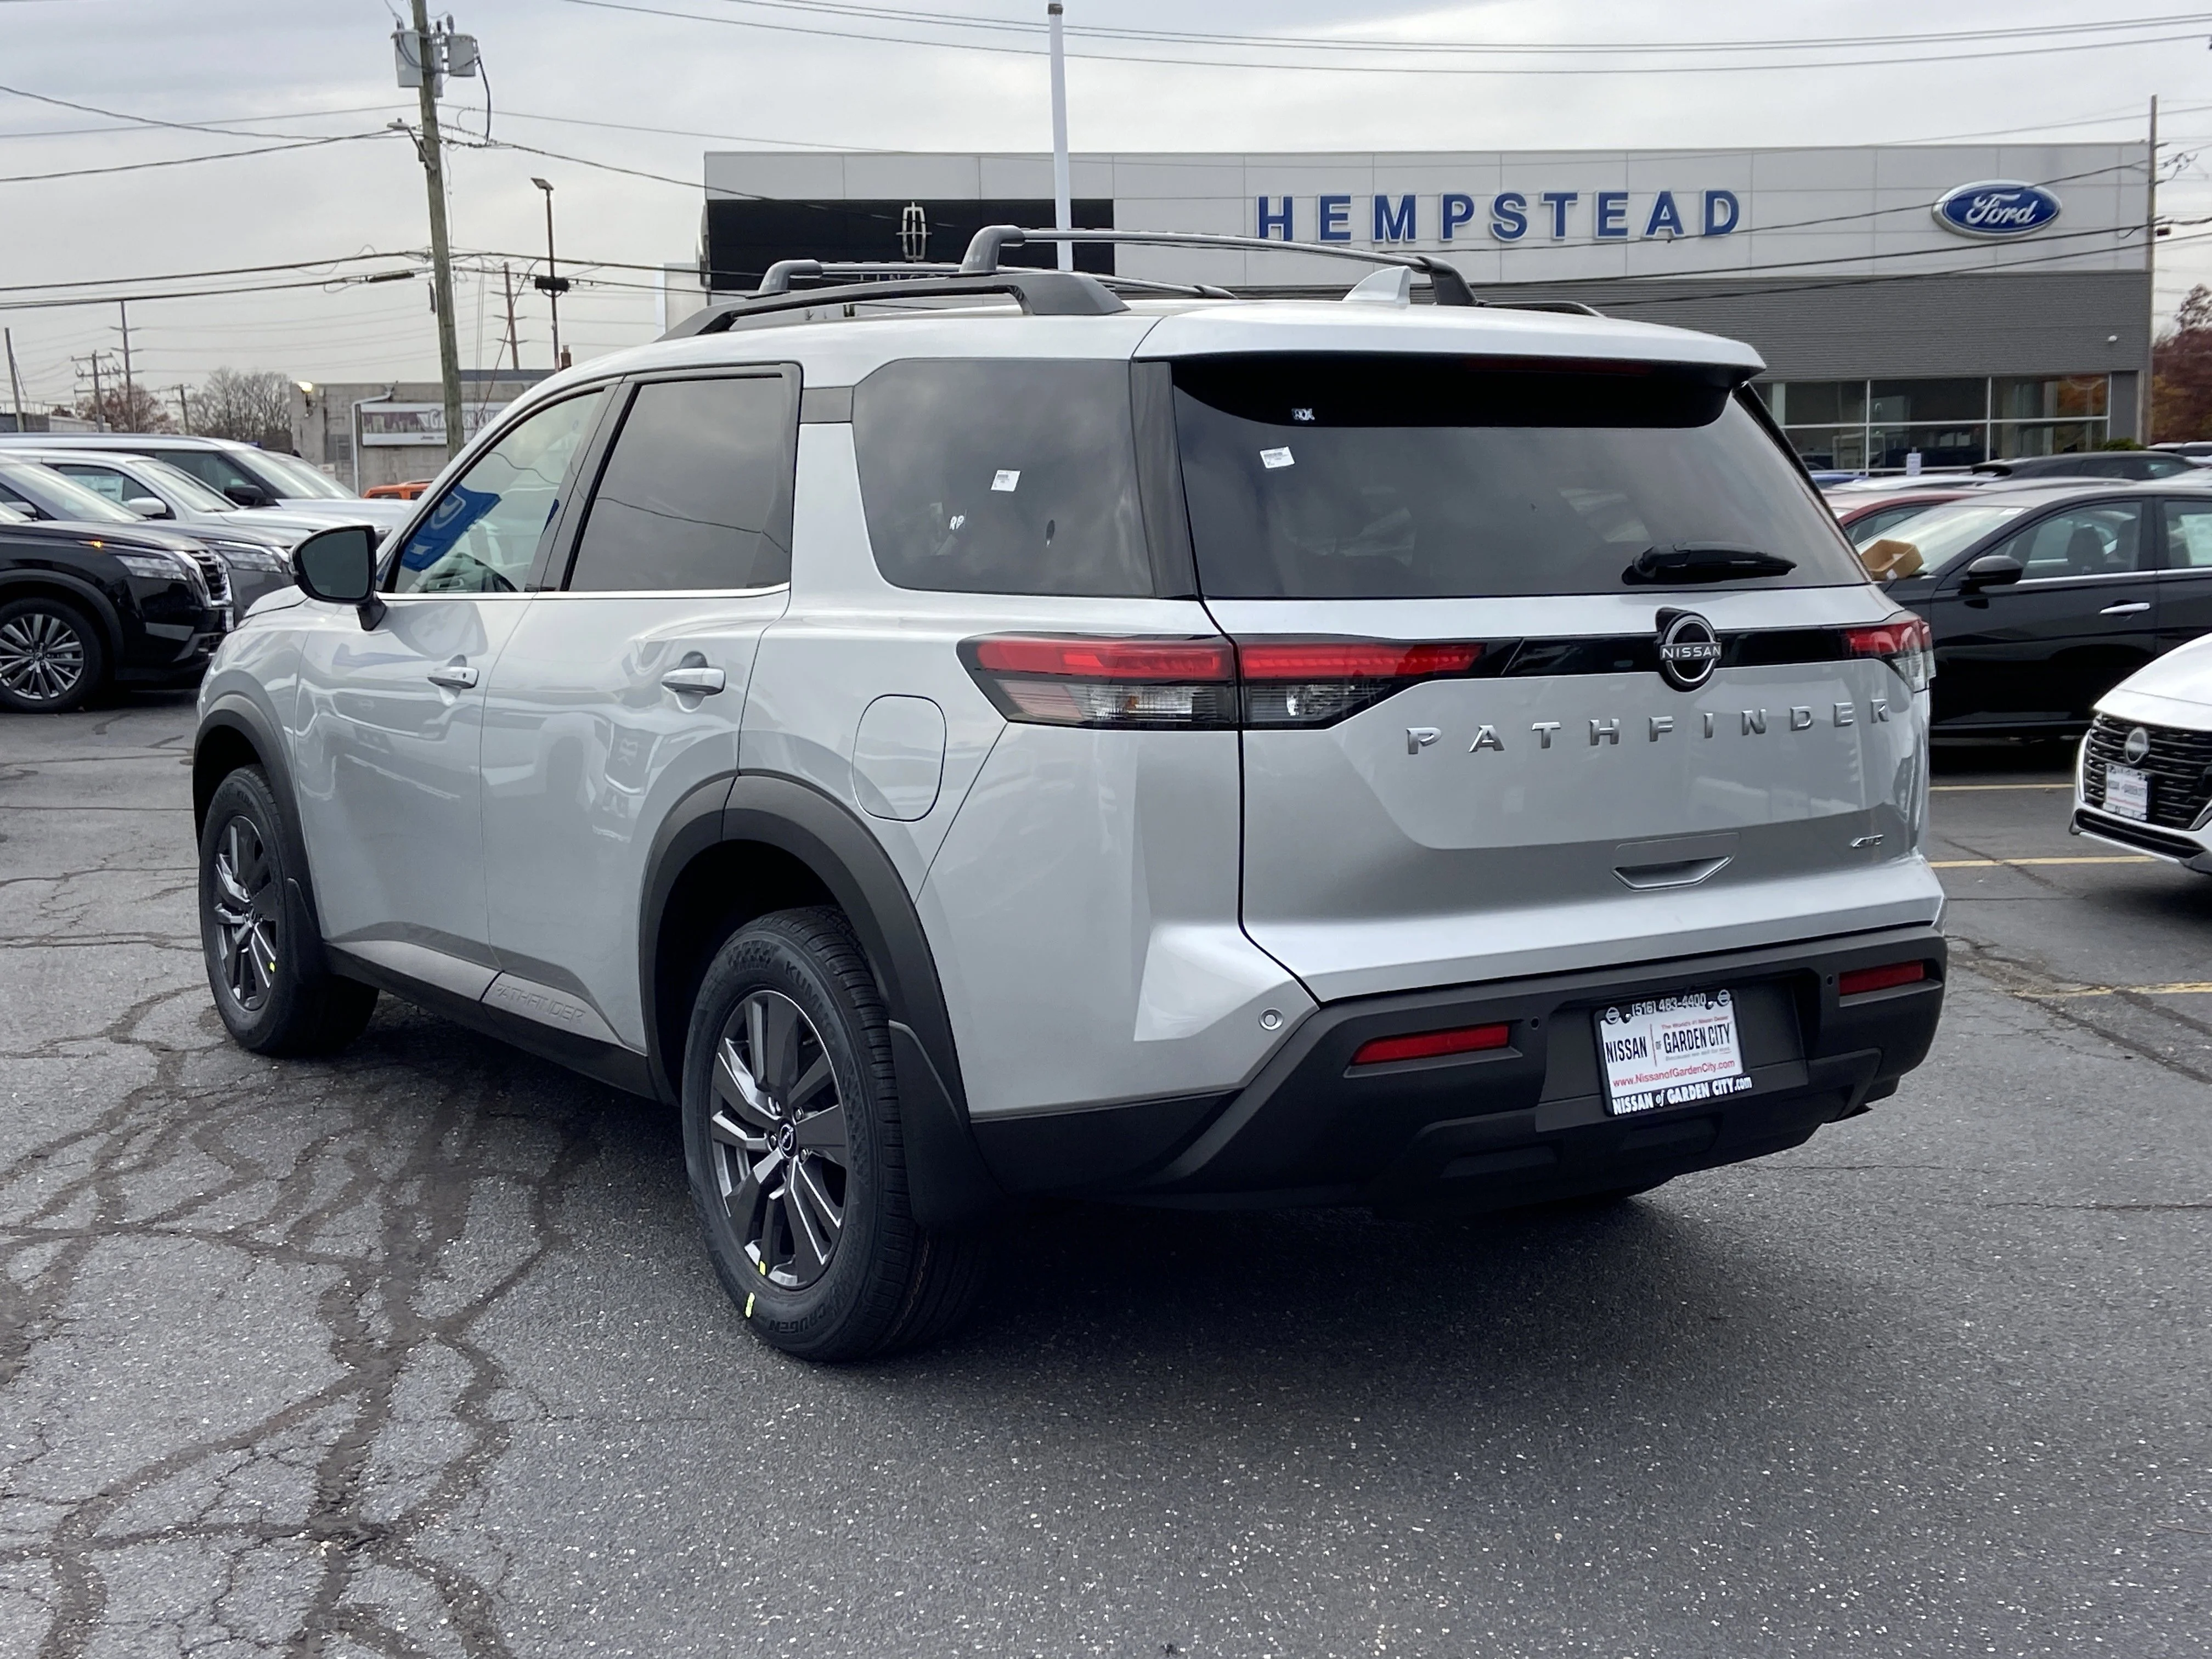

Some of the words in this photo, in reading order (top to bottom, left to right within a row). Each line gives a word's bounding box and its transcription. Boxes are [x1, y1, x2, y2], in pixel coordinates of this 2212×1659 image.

[1256, 188, 1741, 242] HEMPSTEAD
[1966, 193, 2038, 224] Ford
[1662, 646, 1721, 658] NISSAN
[1406, 698, 1891, 755] PATHFINDER
[1632, 1001, 1656, 1017] (516)
[1658, 993, 1706, 1011] 483-4400
[1605, 1036, 1647, 1064] NISSAN
[1663, 1027, 1707, 1054] GARDEN
[1708, 1023, 1730, 1047] CITY
[1613, 1059, 1735, 1088] www.NissanofGardenCity.com
[1612, 1093, 1654, 1115] NISSAN
[1655, 1090, 1665, 1107] of
[1667, 1081, 1711, 1104] GARDEN
[1712, 1076, 1753, 1096] CITY.com
